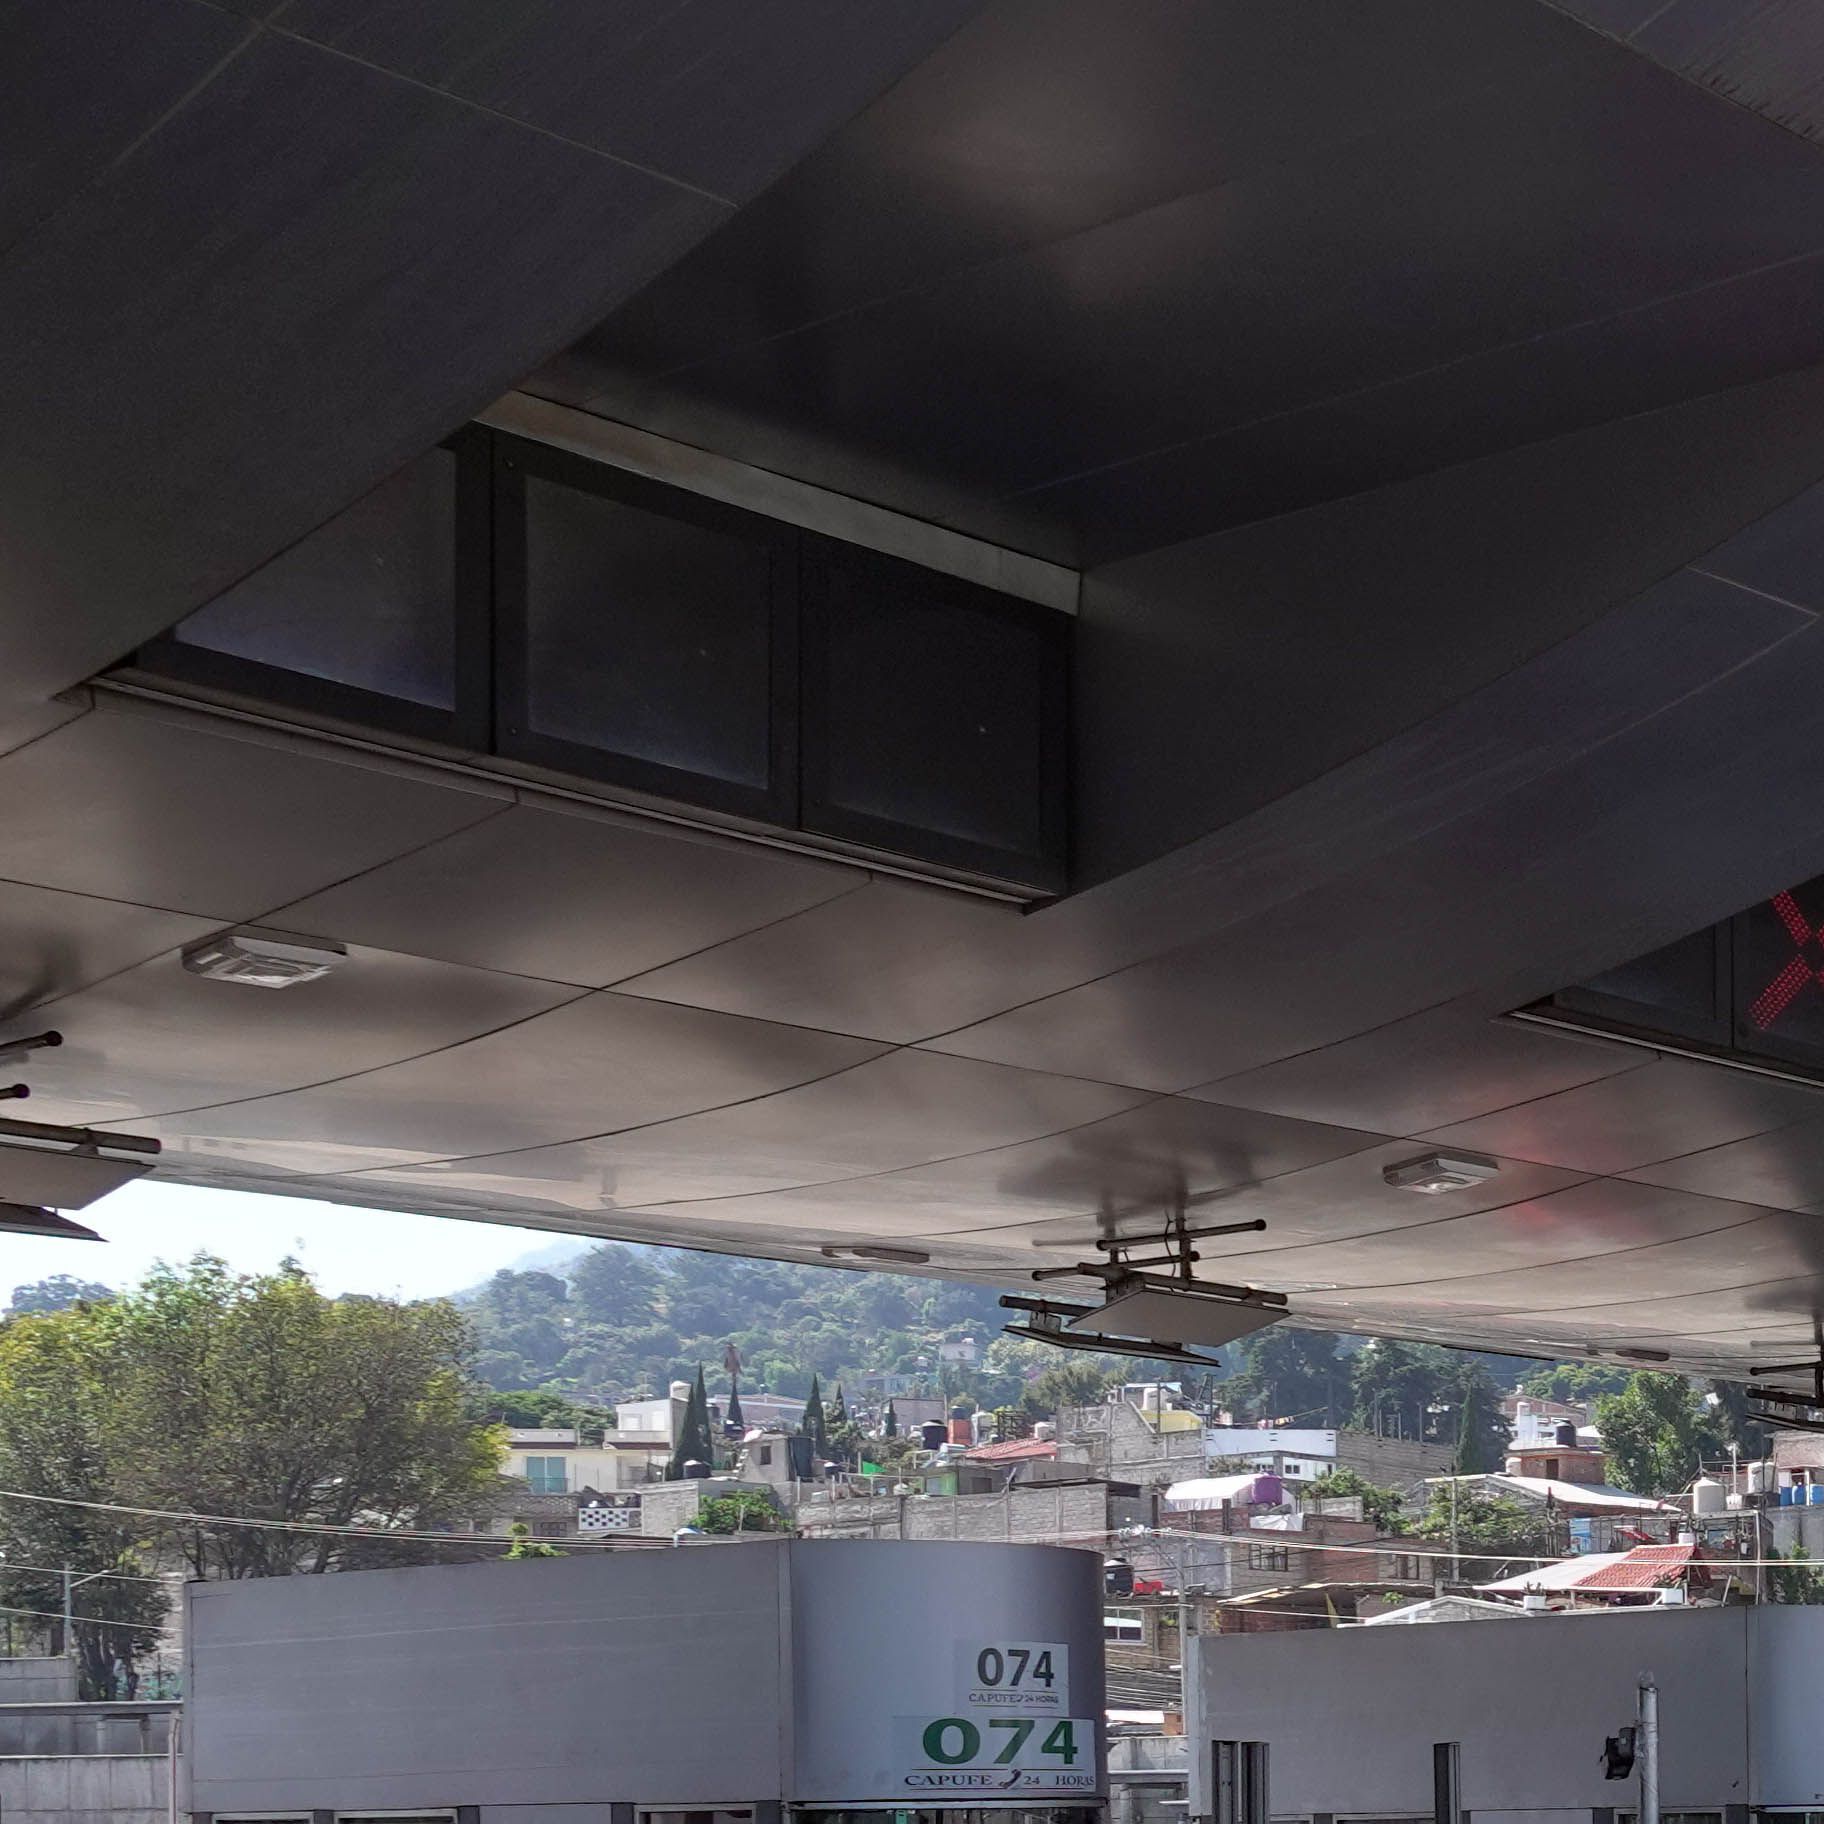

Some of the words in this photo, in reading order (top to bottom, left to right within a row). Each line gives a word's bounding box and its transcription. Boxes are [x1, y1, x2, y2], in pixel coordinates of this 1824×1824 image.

[977, 1647, 1055, 1688] 074
[922, 1717, 1079, 1765] 074
[904, 1775, 993, 1787] CAPUFE
[1023, 1775, 1041, 1786] 24
[1055, 1775, 1095, 1787] HORAS
